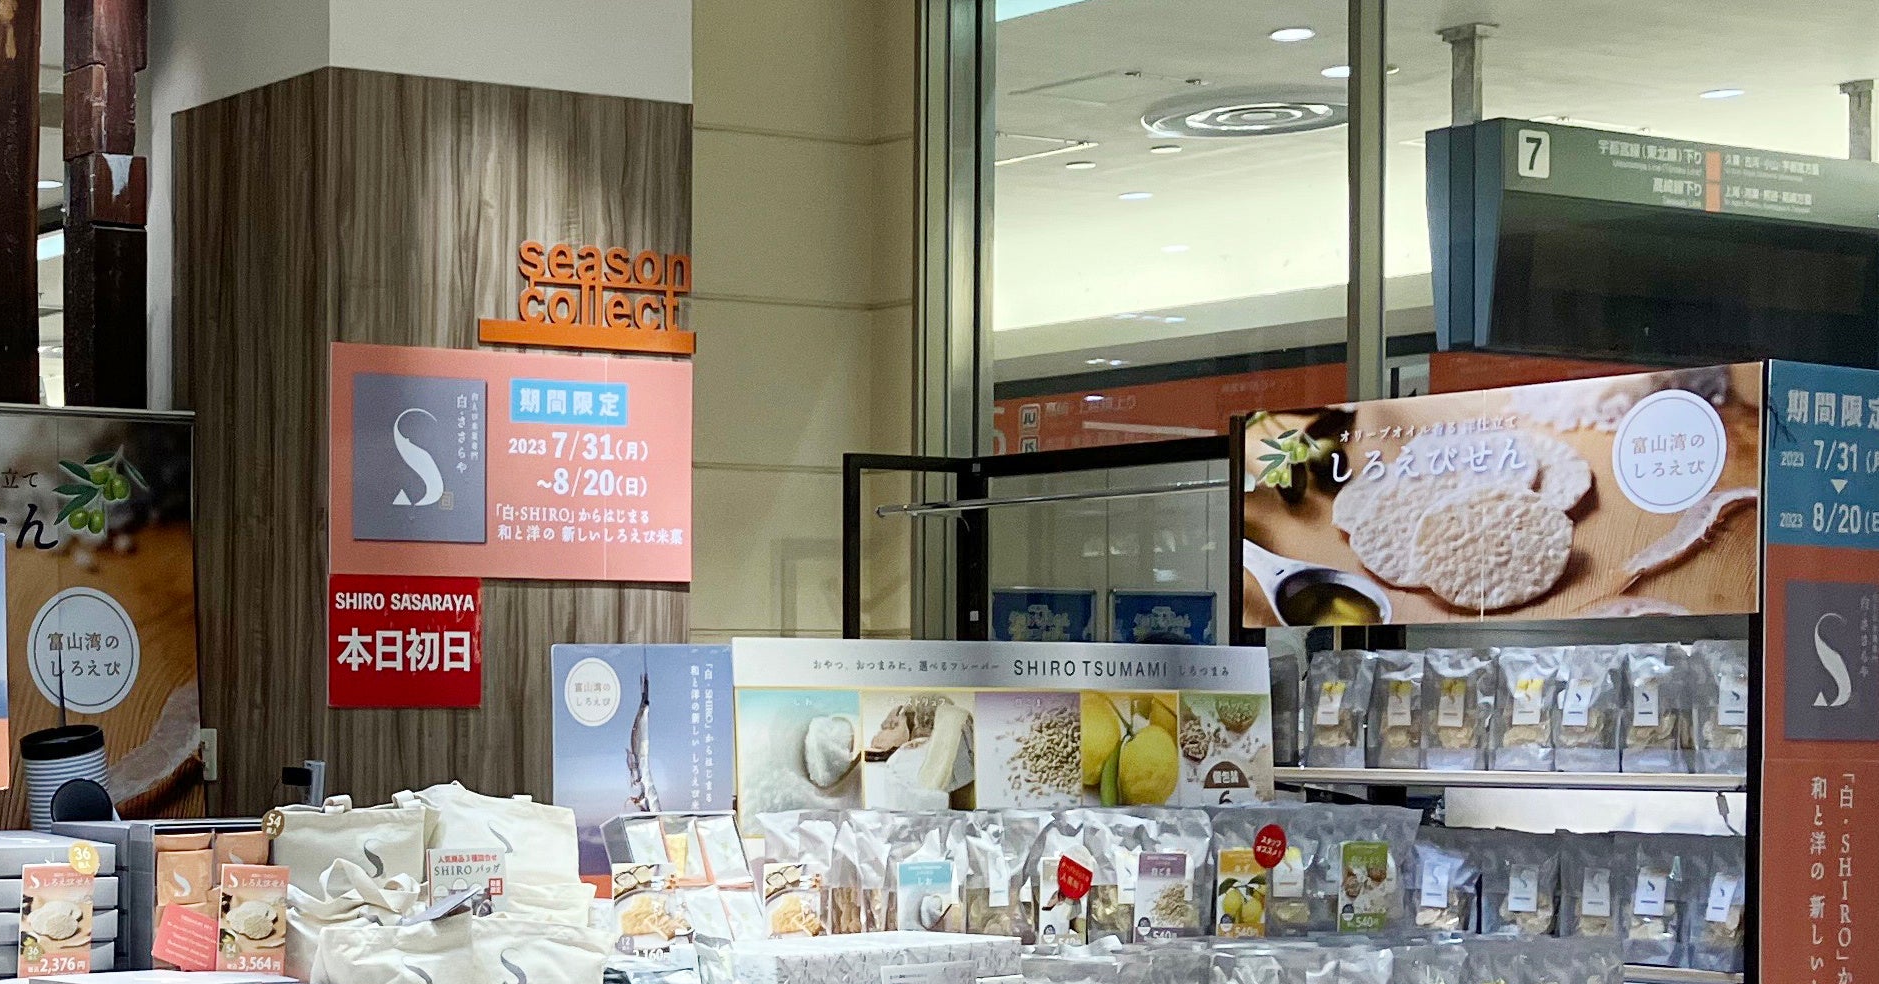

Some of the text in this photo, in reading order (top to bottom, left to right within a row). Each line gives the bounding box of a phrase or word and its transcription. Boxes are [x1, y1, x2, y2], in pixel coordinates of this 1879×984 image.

[1525, 137, 1542, 170] 7
[518, 240, 692, 286] season
[519, 283, 680, 332] collect
[519, 387, 620, 417] 期間限定
[508, 438, 547, 455] 2023
[1631, 433, 1705, 455] 富山湾の
[1331, 438, 1527, 483] しろえびせん
[1633, 458, 1704, 480] しろえび
[334, 592, 475, 612] SHIRO SASARAYA
[46, 631, 120, 654] 富山湾の
[336, 627, 472, 672] 本日初日
[49, 658, 122, 679] しろえび
[1013, 659, 1077, 677] SHIRO
[1081, 660, 1169, 678] TSUMAMI
